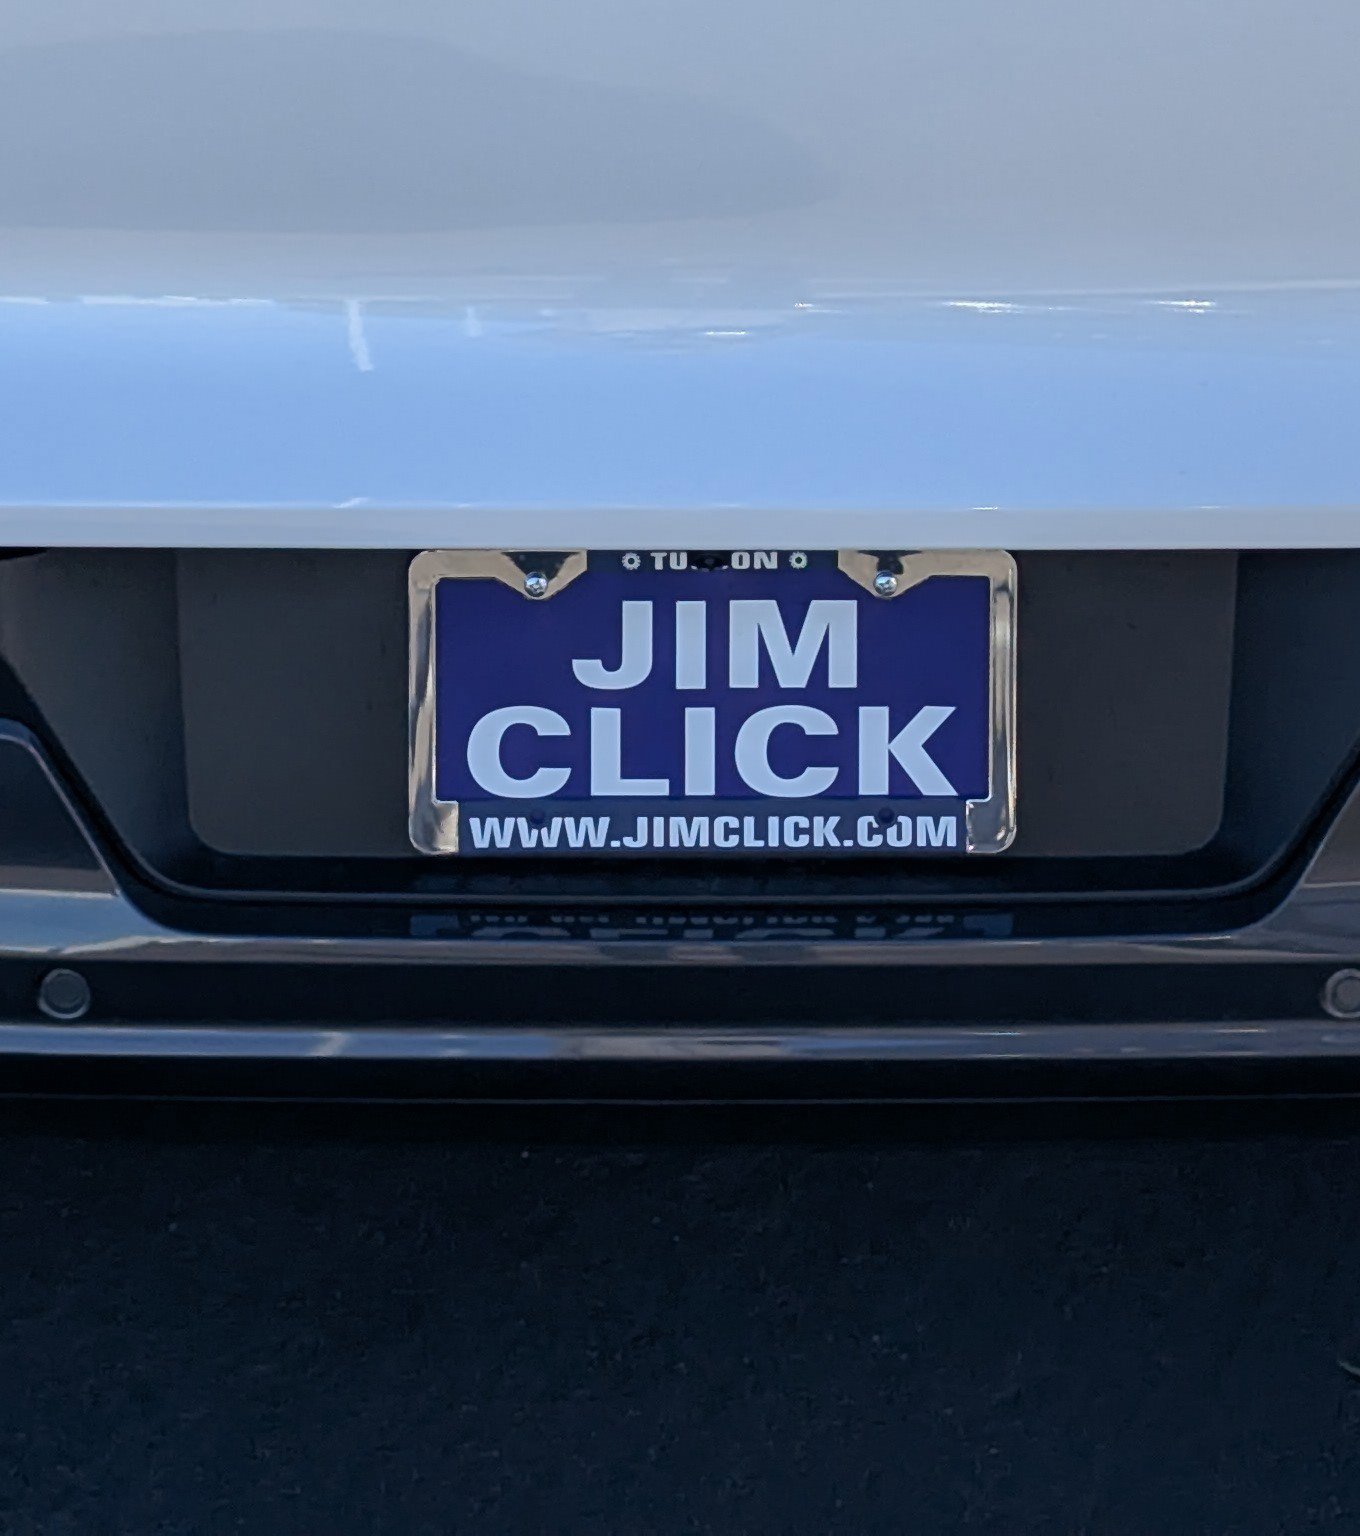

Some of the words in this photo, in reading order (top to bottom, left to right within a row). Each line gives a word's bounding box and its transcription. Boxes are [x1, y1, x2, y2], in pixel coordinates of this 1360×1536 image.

[650, 551, 778, 571] TUON
[571, 599, 858, 690] JIM
[466, 705, 959, 799] CLICK
[468, 815, 958, 849] WWW.JIMCLICK.COM
